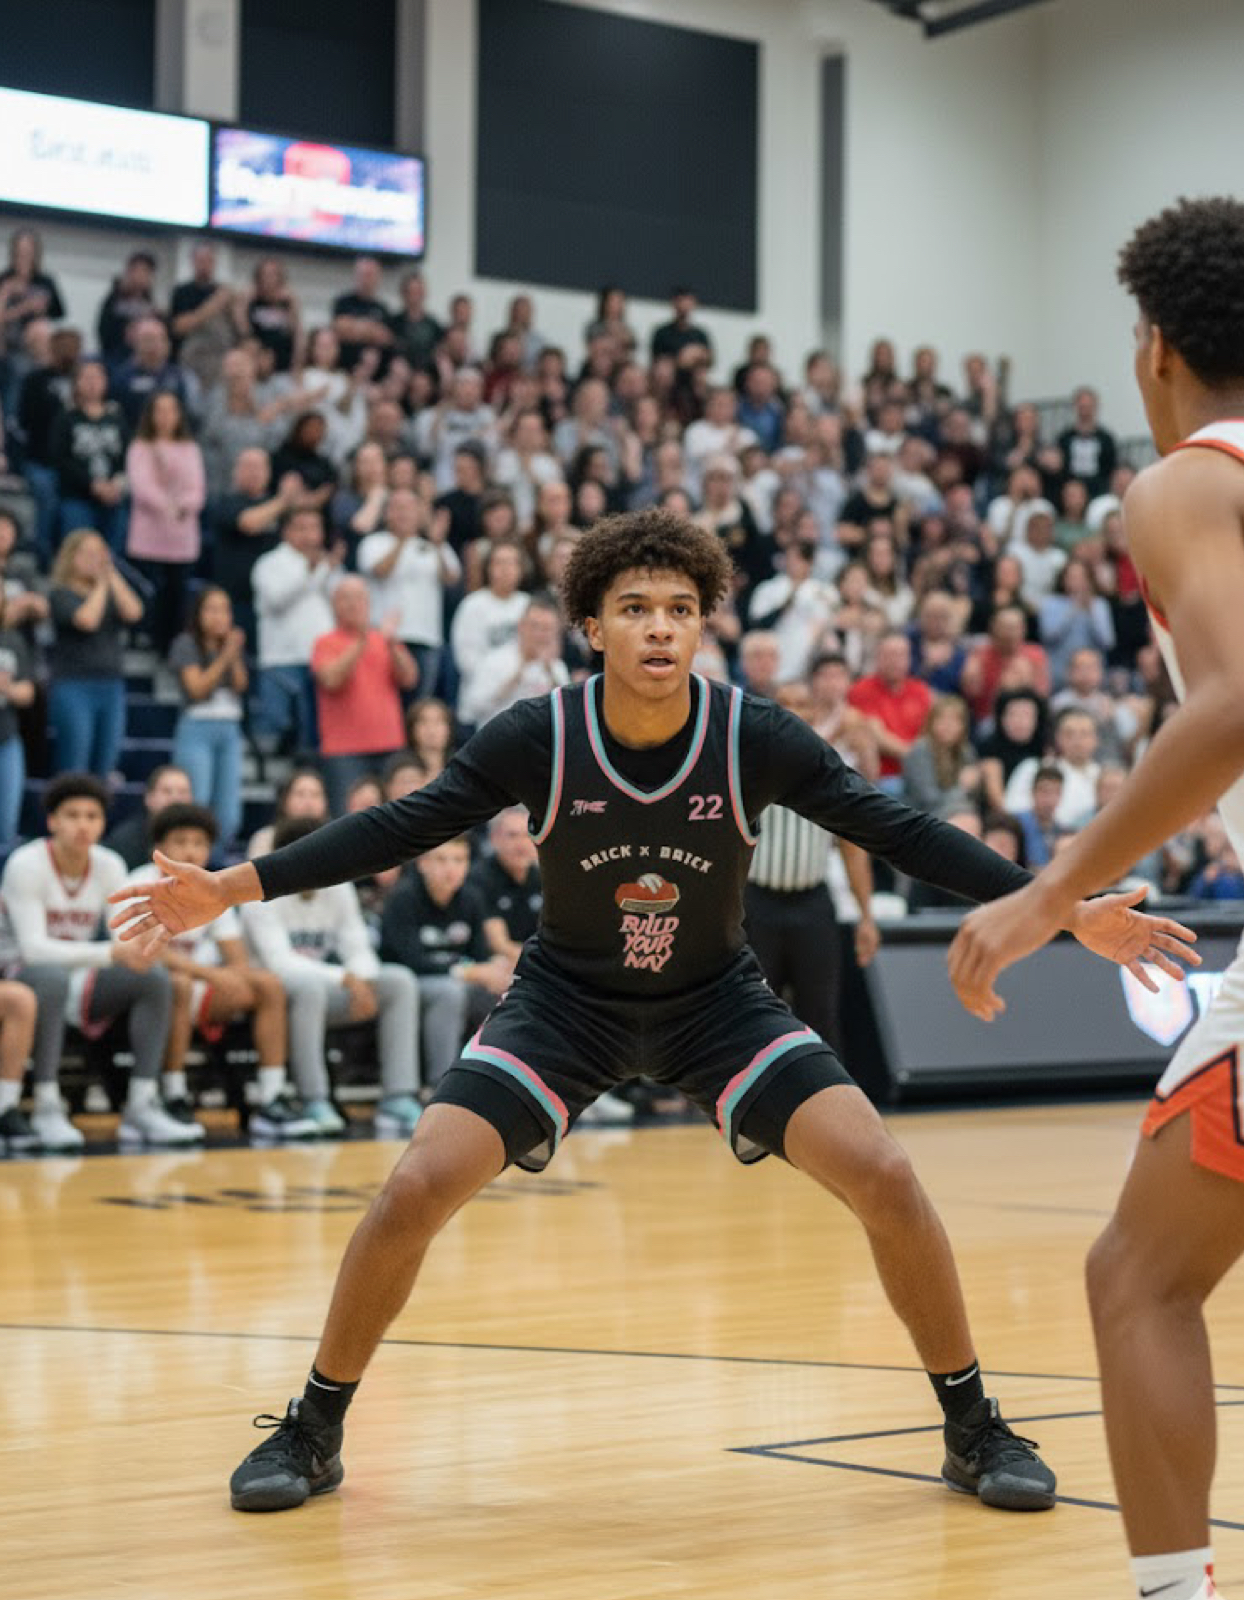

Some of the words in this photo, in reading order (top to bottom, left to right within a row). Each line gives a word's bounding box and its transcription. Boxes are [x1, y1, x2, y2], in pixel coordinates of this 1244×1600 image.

[688, 795, 723, 821] 22
[580, 845, 632, 871] BRICK
[623, 934, 674, 954] YOUR
